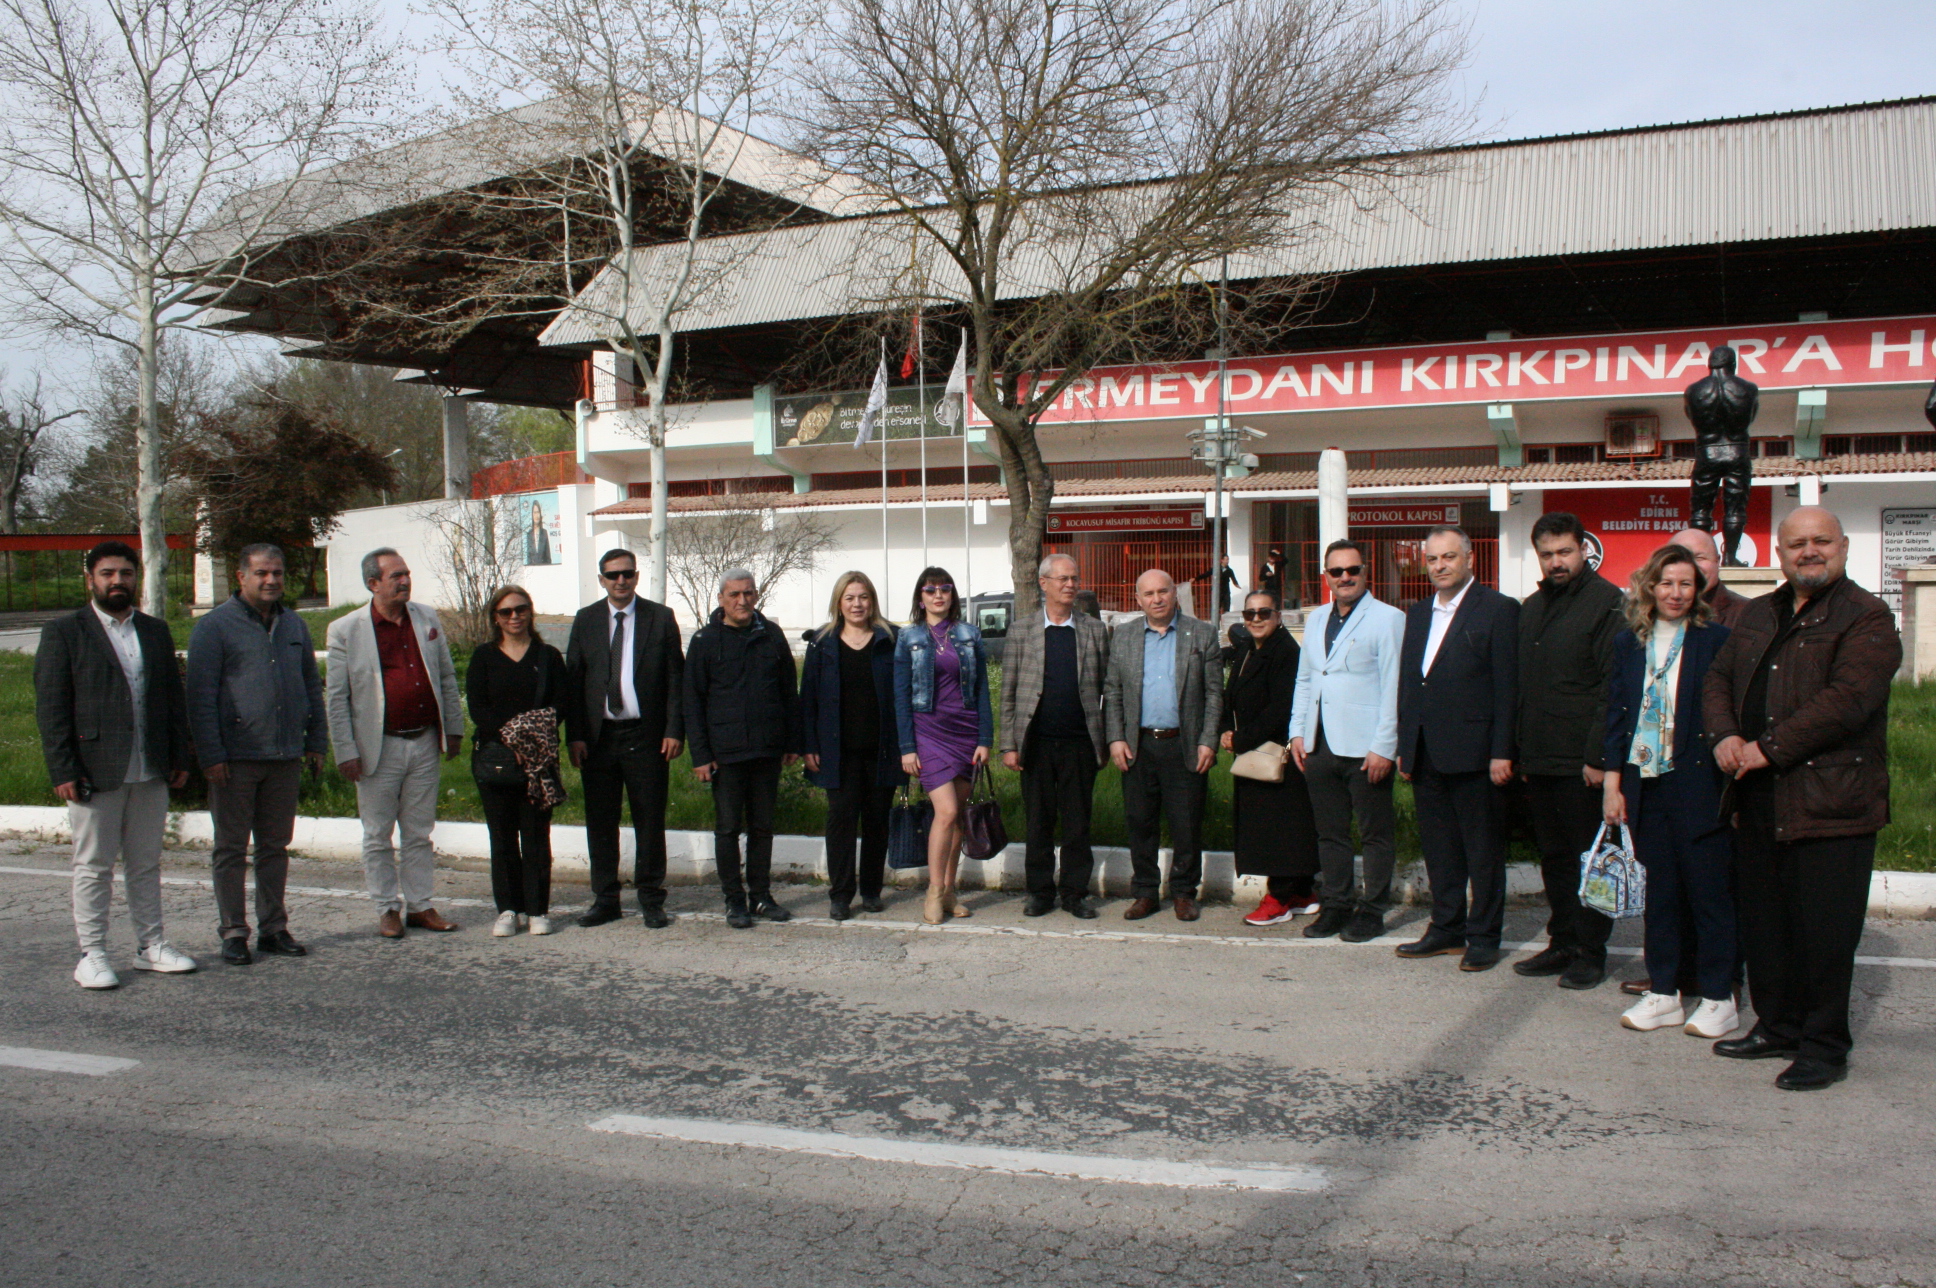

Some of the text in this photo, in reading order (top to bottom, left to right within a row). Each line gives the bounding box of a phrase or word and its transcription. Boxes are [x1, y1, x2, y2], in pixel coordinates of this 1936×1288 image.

[1032, 360, 1374, 411] ERMEYDANI
[1868, 329, 1936, 369] H
[1649, 494, 1669, 505] T.C.
[1406, 510, 1442, 521] KAPISI
[1640, 506, 1679, 518] EDİRNE
[1066, 518, 1103, 527] KOCAYUSUF
[1105, 516, 1131, 526] MİSAFİR
[1132, 515, 1161, 525] TRİBÜNÜ
[1162, 516, 1184, 524] KAPISI
[1602, 518, 1650, 531] BELEDİYE
[1884, 530, 1904, 538] Büyük
